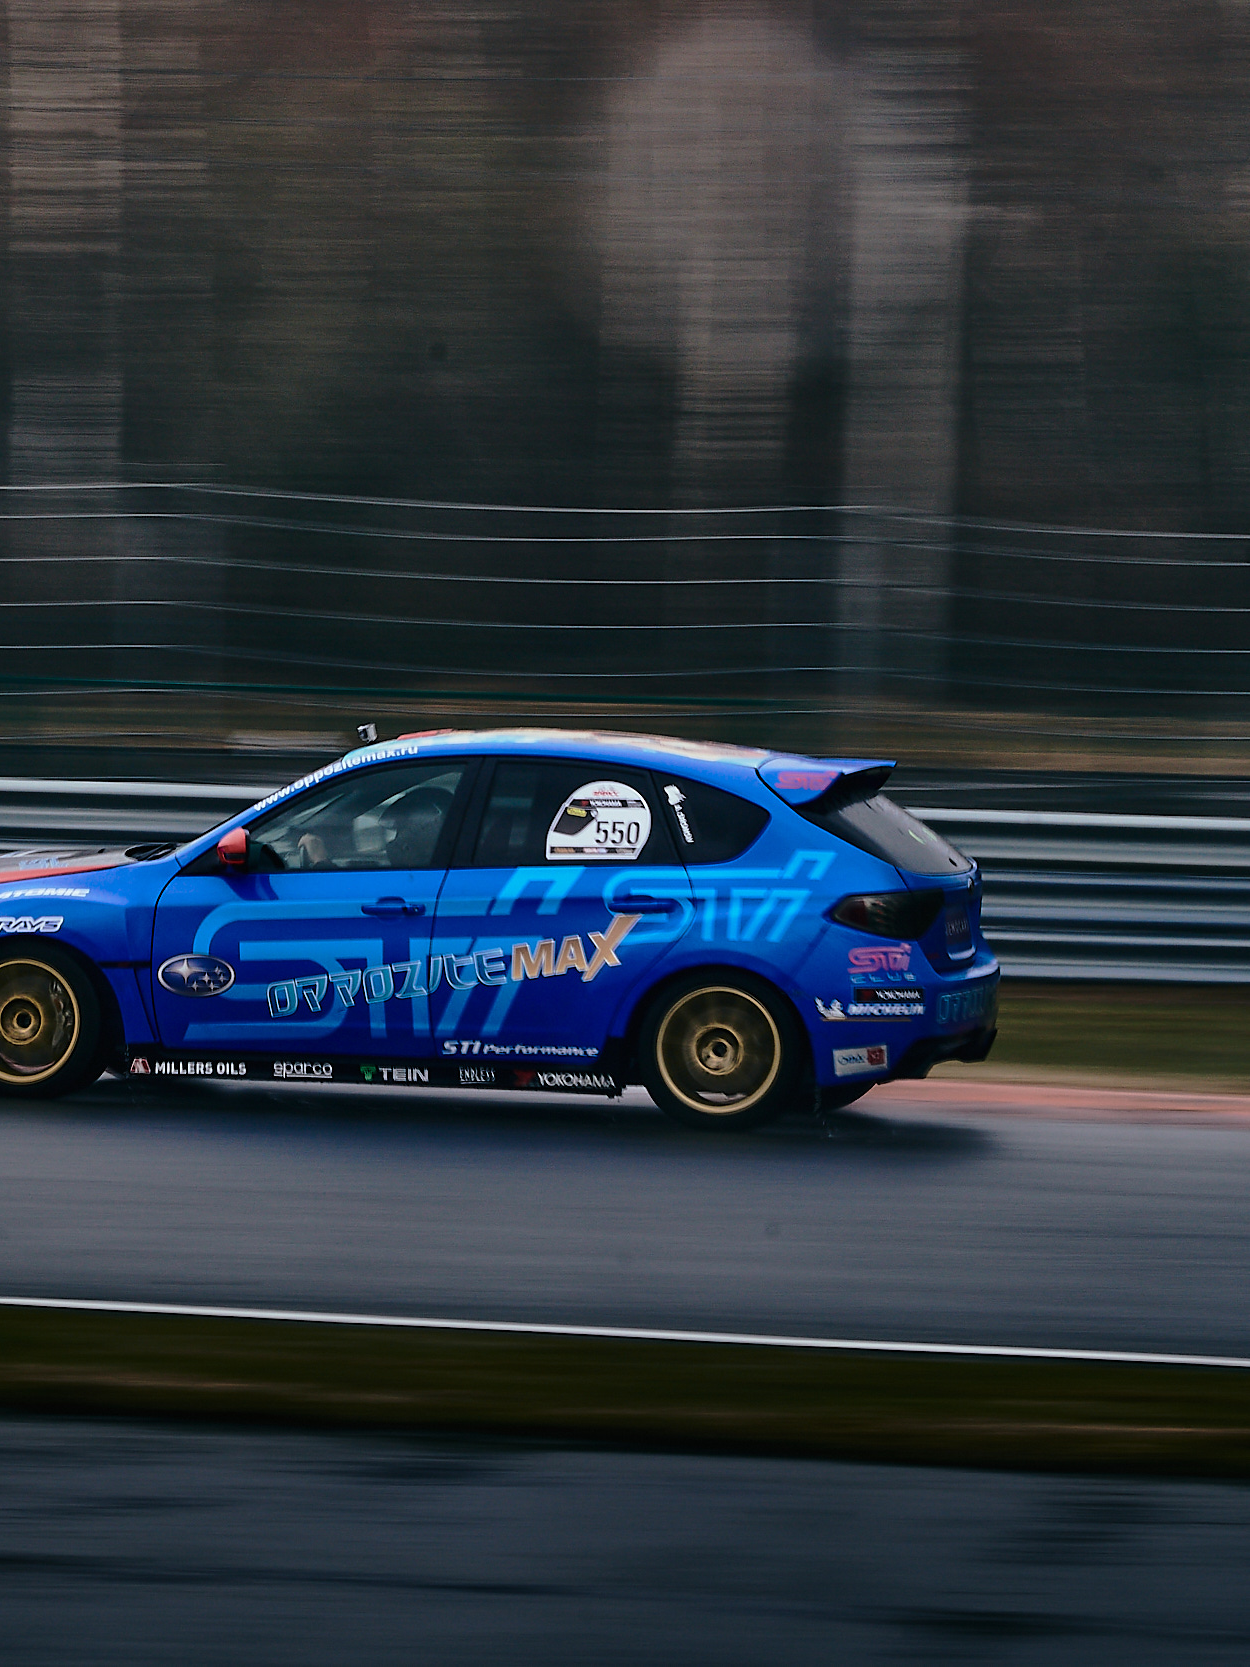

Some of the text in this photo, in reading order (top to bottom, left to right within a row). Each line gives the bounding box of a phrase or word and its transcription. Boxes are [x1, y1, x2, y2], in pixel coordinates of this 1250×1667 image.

[253, 746, 419, 812] www.oppozitemax.ru
[594, 820, 641, 845] 550
[847, 1003, 926, 1017] MICHELIN
[442, 1040, 600, 1058] STI Performance
[154, 1061, 248, 1076] MILLERS OILS
[273, 1061, 334, 1079] sparco
[378, 1066, 430, 1083] TEIN
[458, 1066, 497, 1084] ENDLESS
[536, 1071, 617, 1089] YOKOHAMA
